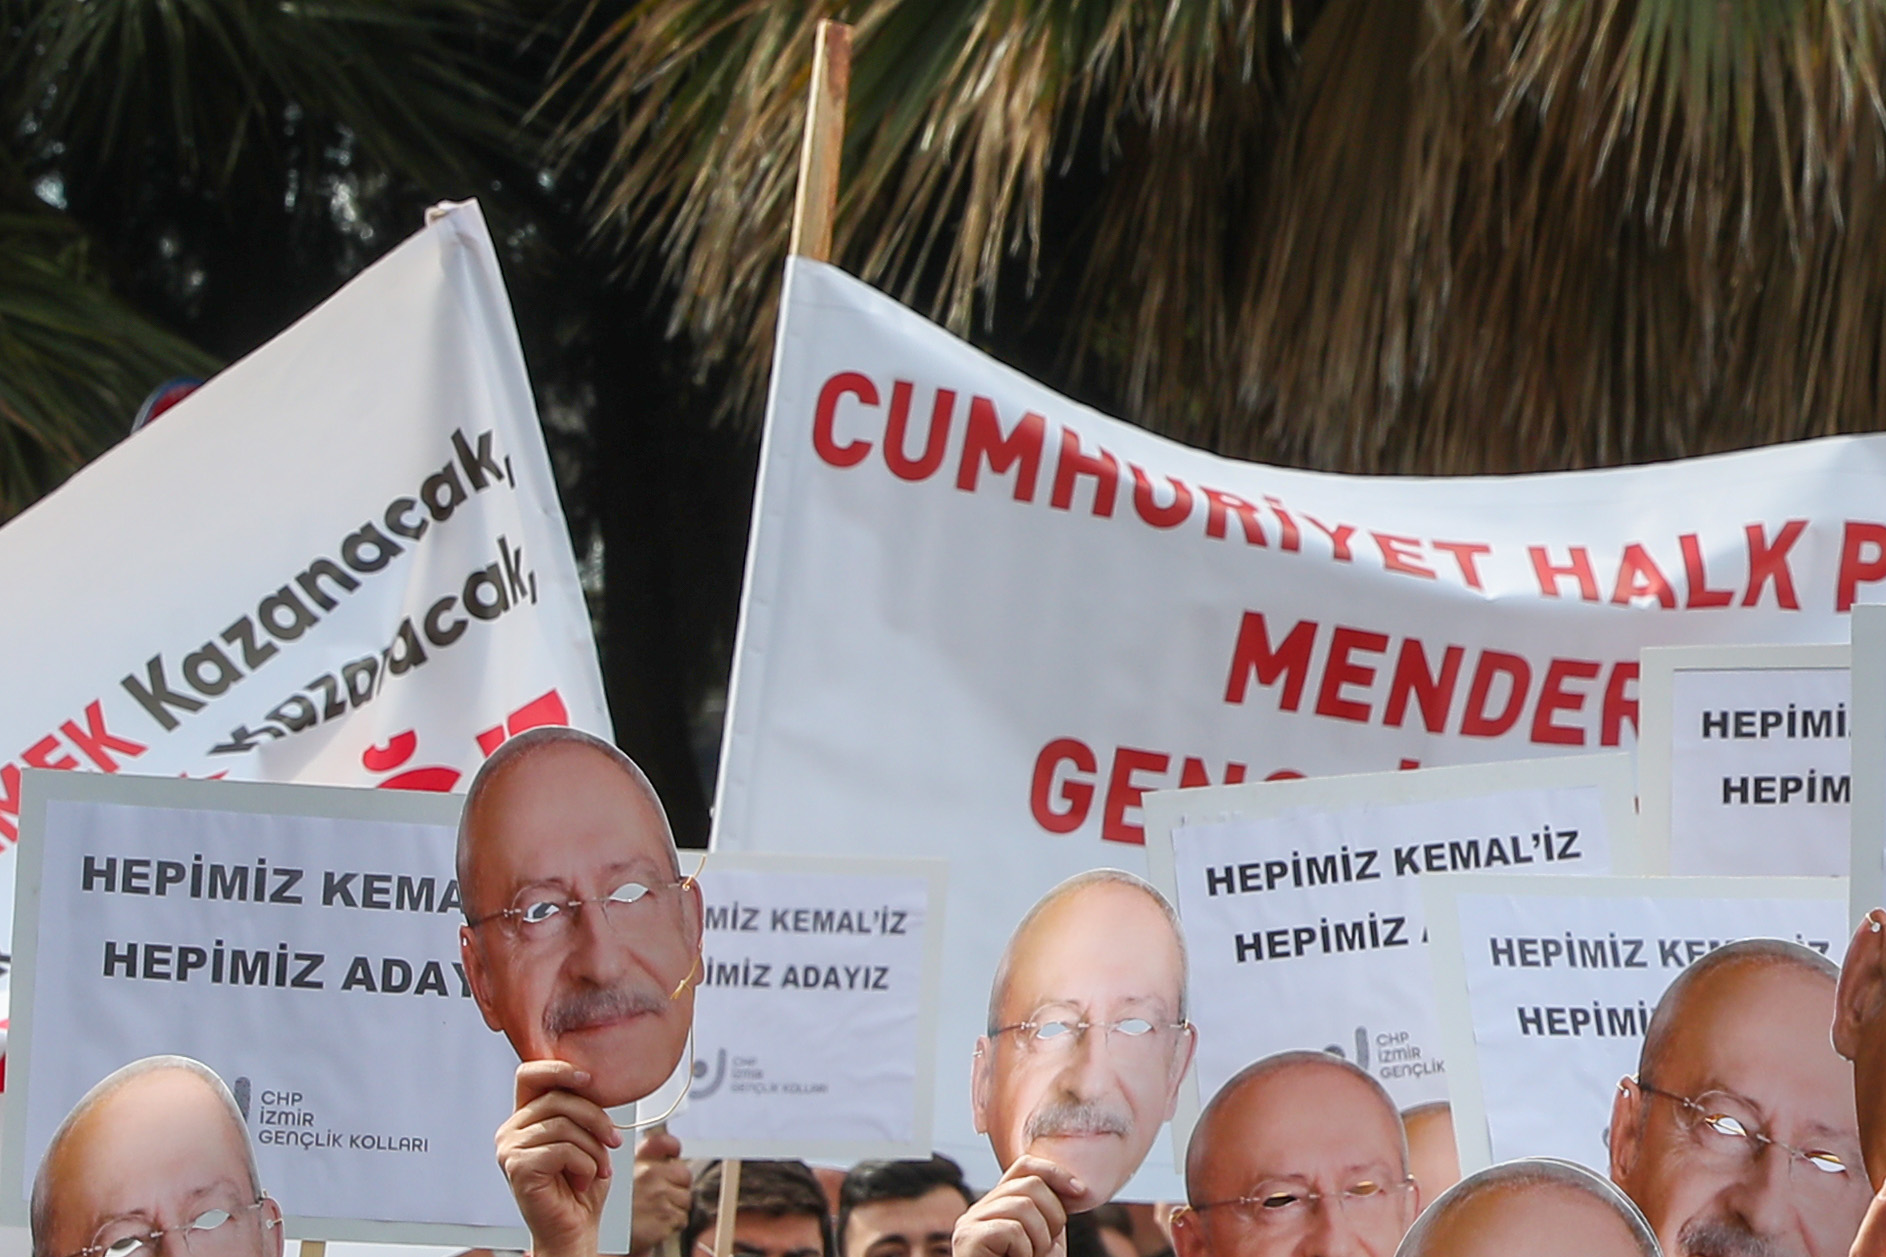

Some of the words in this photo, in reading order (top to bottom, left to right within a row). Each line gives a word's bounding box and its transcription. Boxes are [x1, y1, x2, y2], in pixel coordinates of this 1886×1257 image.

[813, 372, 1492, 592] CUMHURİYET
[1528, 519, 1809, 610] HALK
[120, 427, 515, 732] Kazanacak,
[1703, 703, 1850, 739] HEPİMİ
[82, 853, 303, 904] HEPİMİZ
[1206, 845, 1380, 896] HEPİMİZ
[1394, 825, 1581, 876] KEMAL’İZ
[771, 905, 908, 935] KEMAL’İZ
[1235, 912, 1409, 964] HEPİMİZ
[103, 939, 324, 990] HEPİMİZ
[1490, 932, 1647, 968] HEPİMİZ
[781, 965, 889, 990] ADAYIZ
[1377, 1031, 1409, 1046] CHP
[261, 1090, 303, 1106] CHP
[258, 1129, 343, 1151] GENÇLİK
[350, 1134, 428, 1152] KOLLARI
